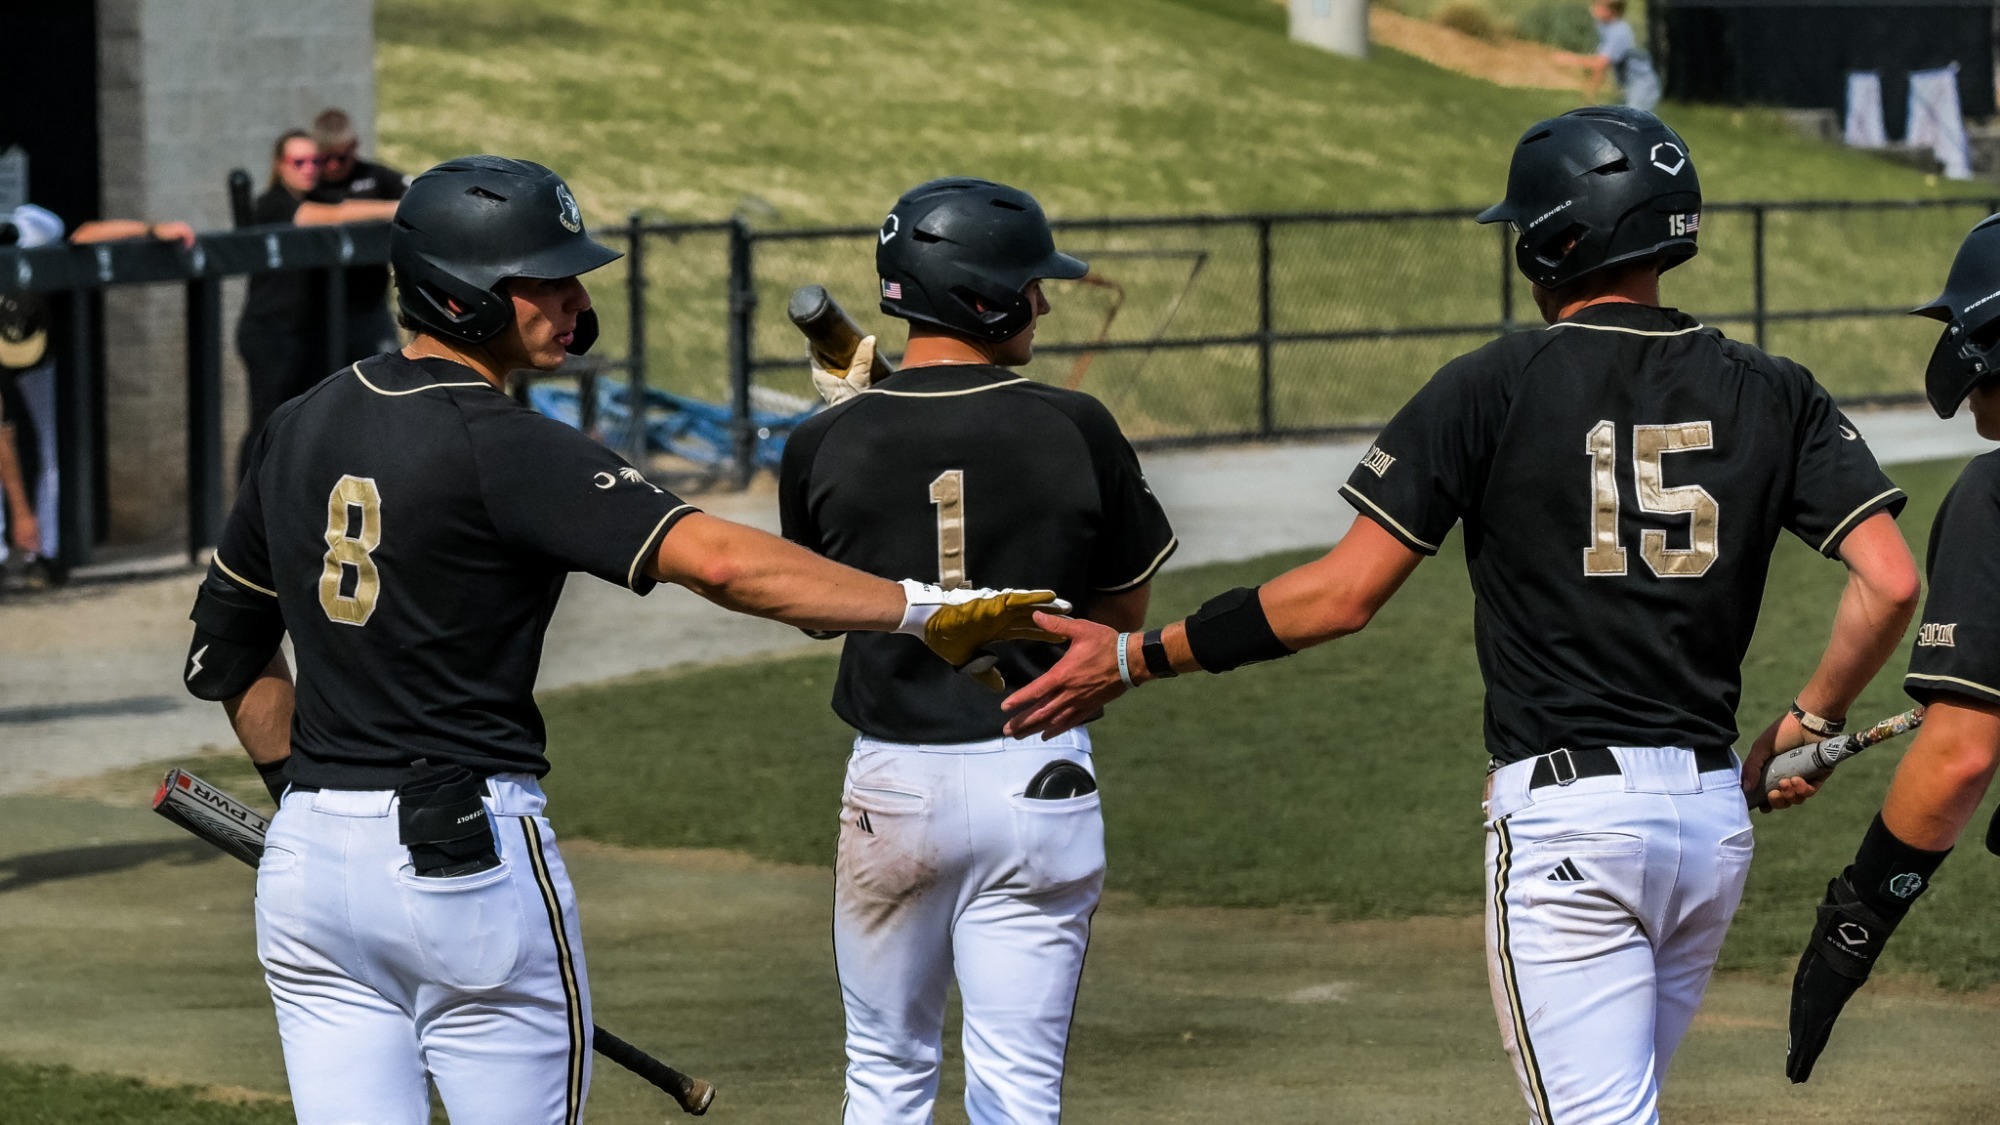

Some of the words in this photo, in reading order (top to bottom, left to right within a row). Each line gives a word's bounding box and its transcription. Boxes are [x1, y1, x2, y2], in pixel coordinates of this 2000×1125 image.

[1529, 199, 1572, 228] EVOSHIELD
[1668, 213, 1685, 236] 15
[1584, 420, 1719, 577] 15
[929, 469, 973, 591] 1
[319, 474, 382, 627] 8
[1917, 622, 1958, 647] SOCON
[194, 784, 247, 821] PWR
